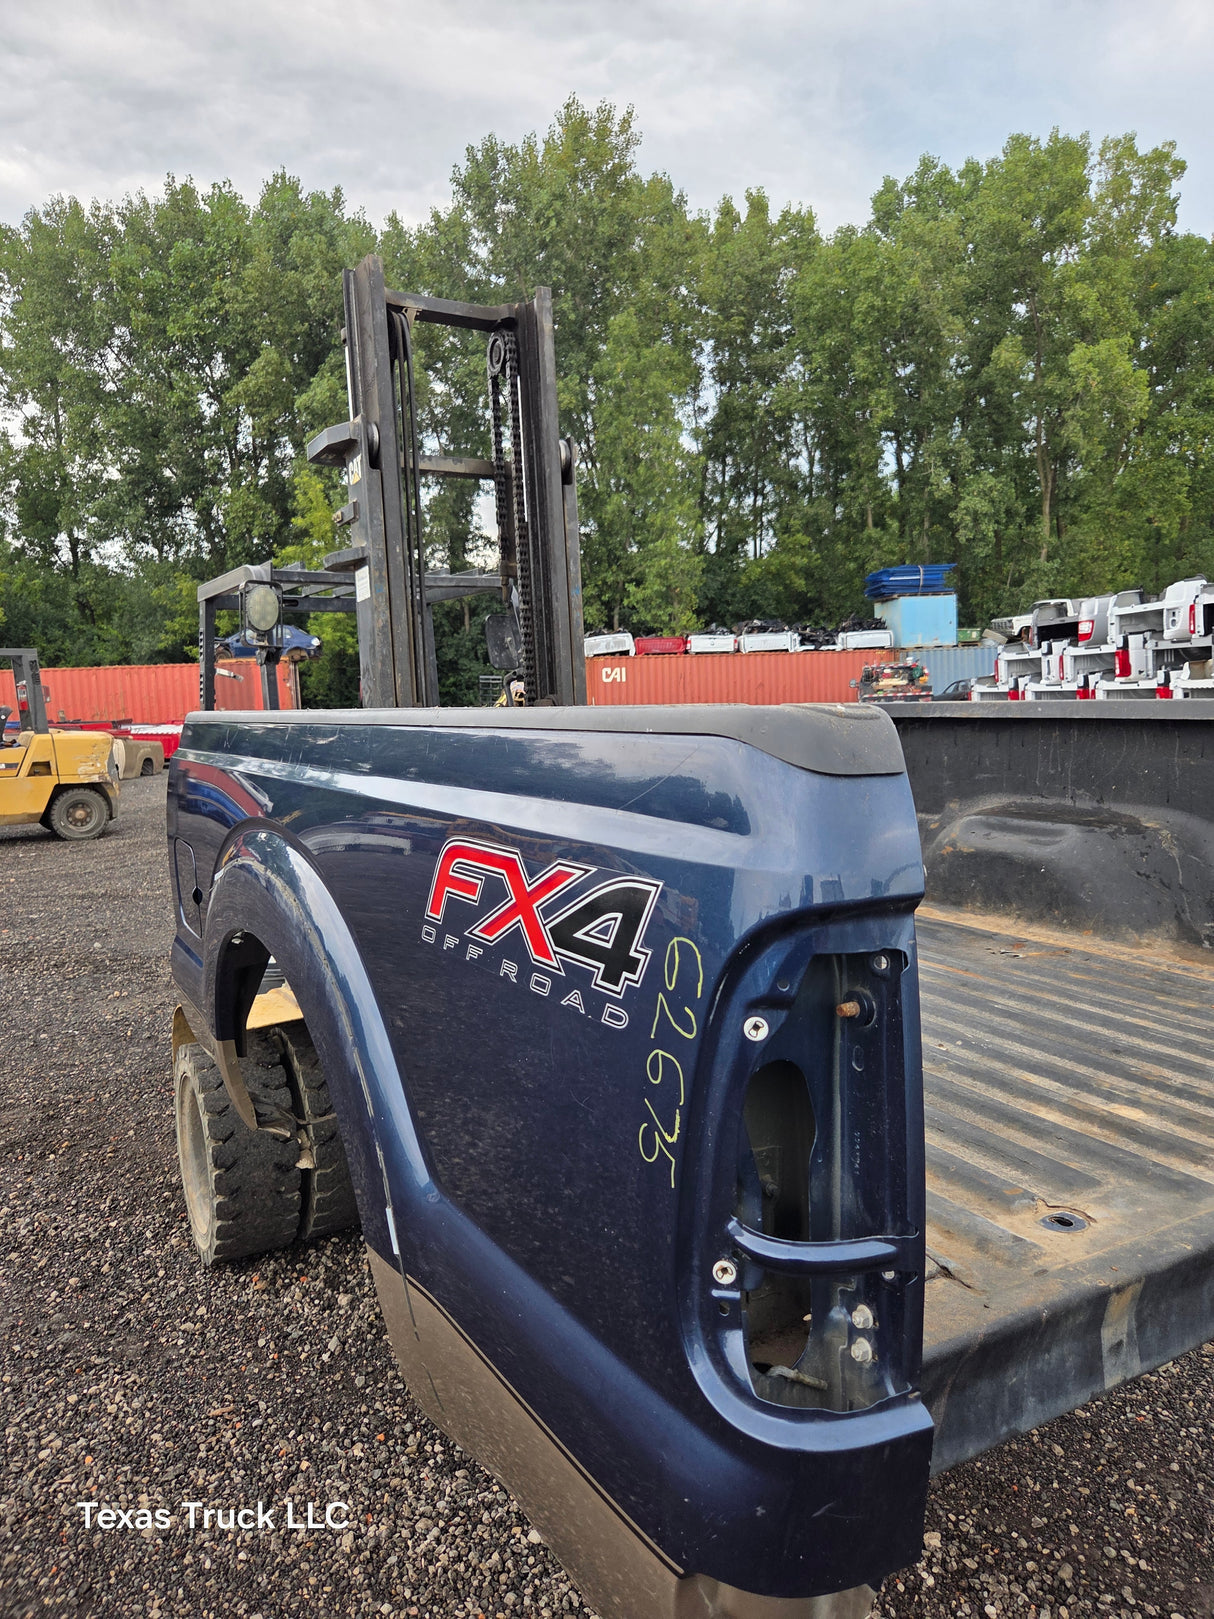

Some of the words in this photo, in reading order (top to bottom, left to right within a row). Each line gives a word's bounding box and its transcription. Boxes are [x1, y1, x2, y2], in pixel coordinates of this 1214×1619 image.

[601, 667, 626, 683] CAI
[421, 924, 483, 960] OFF
[499, 959, 629, 1029] ROAD
[424, 836, 664, 999] FX4
[639, 936, 703, 1189] 62675
